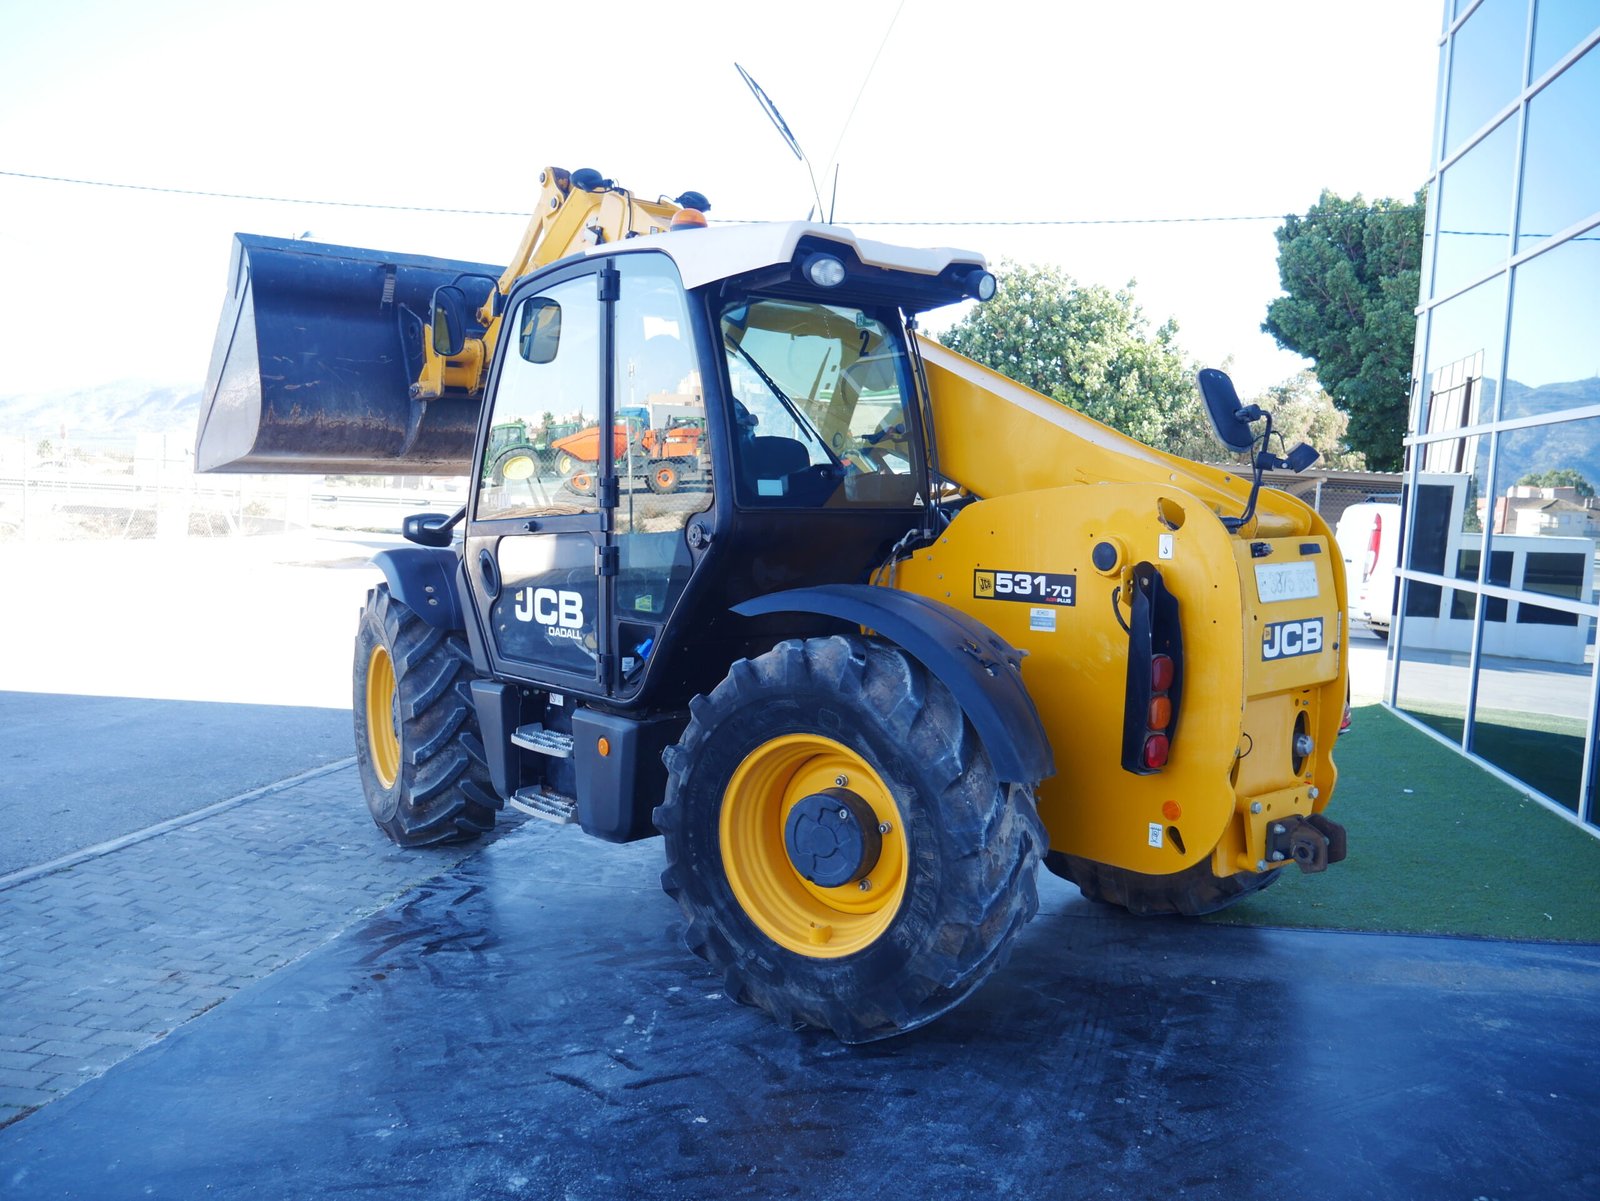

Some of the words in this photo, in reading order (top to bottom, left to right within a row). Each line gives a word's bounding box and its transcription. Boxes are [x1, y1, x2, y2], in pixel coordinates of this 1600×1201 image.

[859, 330, 870, 357] 2
[995, 572, 1072, 597] 531-70
[515, 586, 584, 629] JCB
[1263, 620, 1322, 658] JCB
